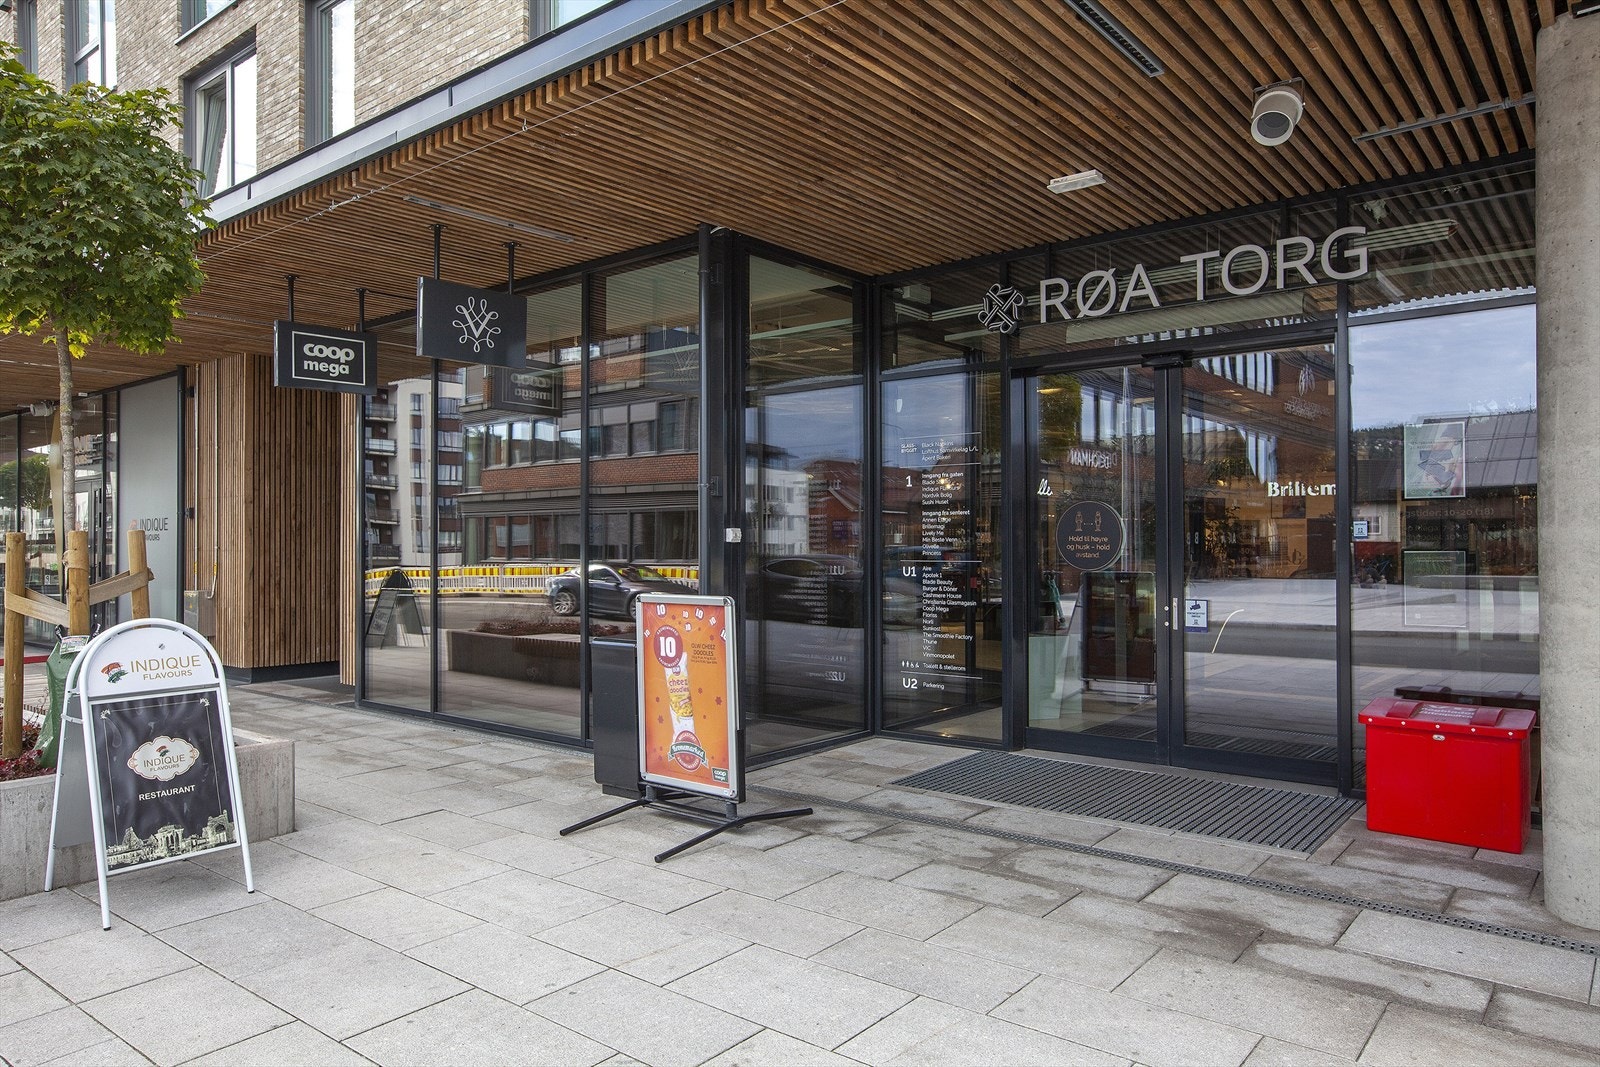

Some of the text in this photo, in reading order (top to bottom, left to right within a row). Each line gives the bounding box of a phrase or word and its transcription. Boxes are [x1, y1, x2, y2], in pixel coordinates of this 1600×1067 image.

[1040, 226, 1369, 324] RØA TORG
[303, 343, 355, 363] coop
[304, 360, 350, 377] mega
[906, 475, 912, 487] 1
[139, 518, 168, 531] INDIQUE
[902, 566, 917, 577] U1
[657, 604, 665, 615] 10
[660, 636, 676, 658] 10
[923, 652, 955, 660] Vinmonopolet
[131, 655, 201, 672] INDIQUE
[143, 670, 193, 680] FLAVOURS
[902, 678, 918, 689] U2
[923, 682, 945, 690] Parkering
[144, 754, 185, 767] INDIQUE
[138, 785, 195, 801] RESTAURANT
